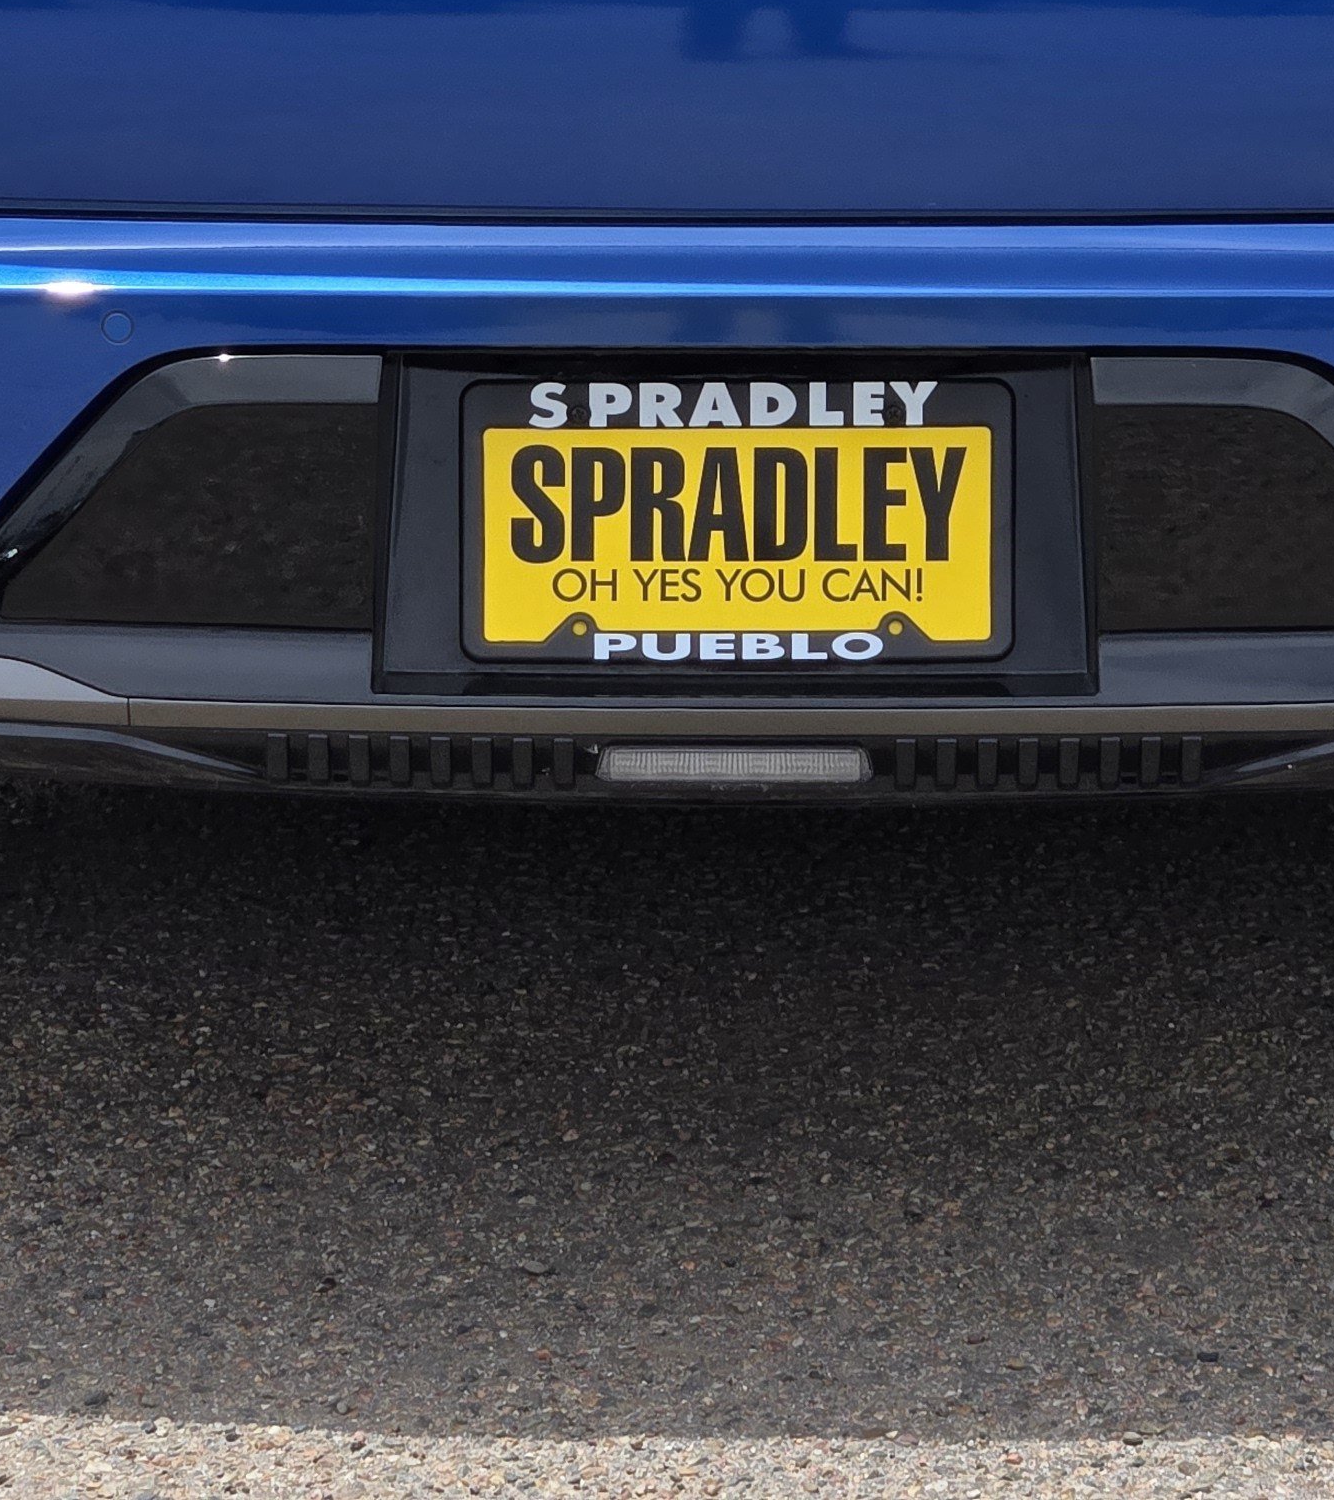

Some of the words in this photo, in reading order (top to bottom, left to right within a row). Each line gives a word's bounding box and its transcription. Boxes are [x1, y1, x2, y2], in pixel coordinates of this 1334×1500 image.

[528, 381, 939, 428] SPRADLEY
[510, 444, 968, 563] SPRADLEY
[552, 567, 619, 603] OH
[632, 567, 702, 603] YES
[714, 567, 806, 603] YOU
[821, 567, 924, 603] CAN!
[592, 632, 885, 661] PUEBLO
